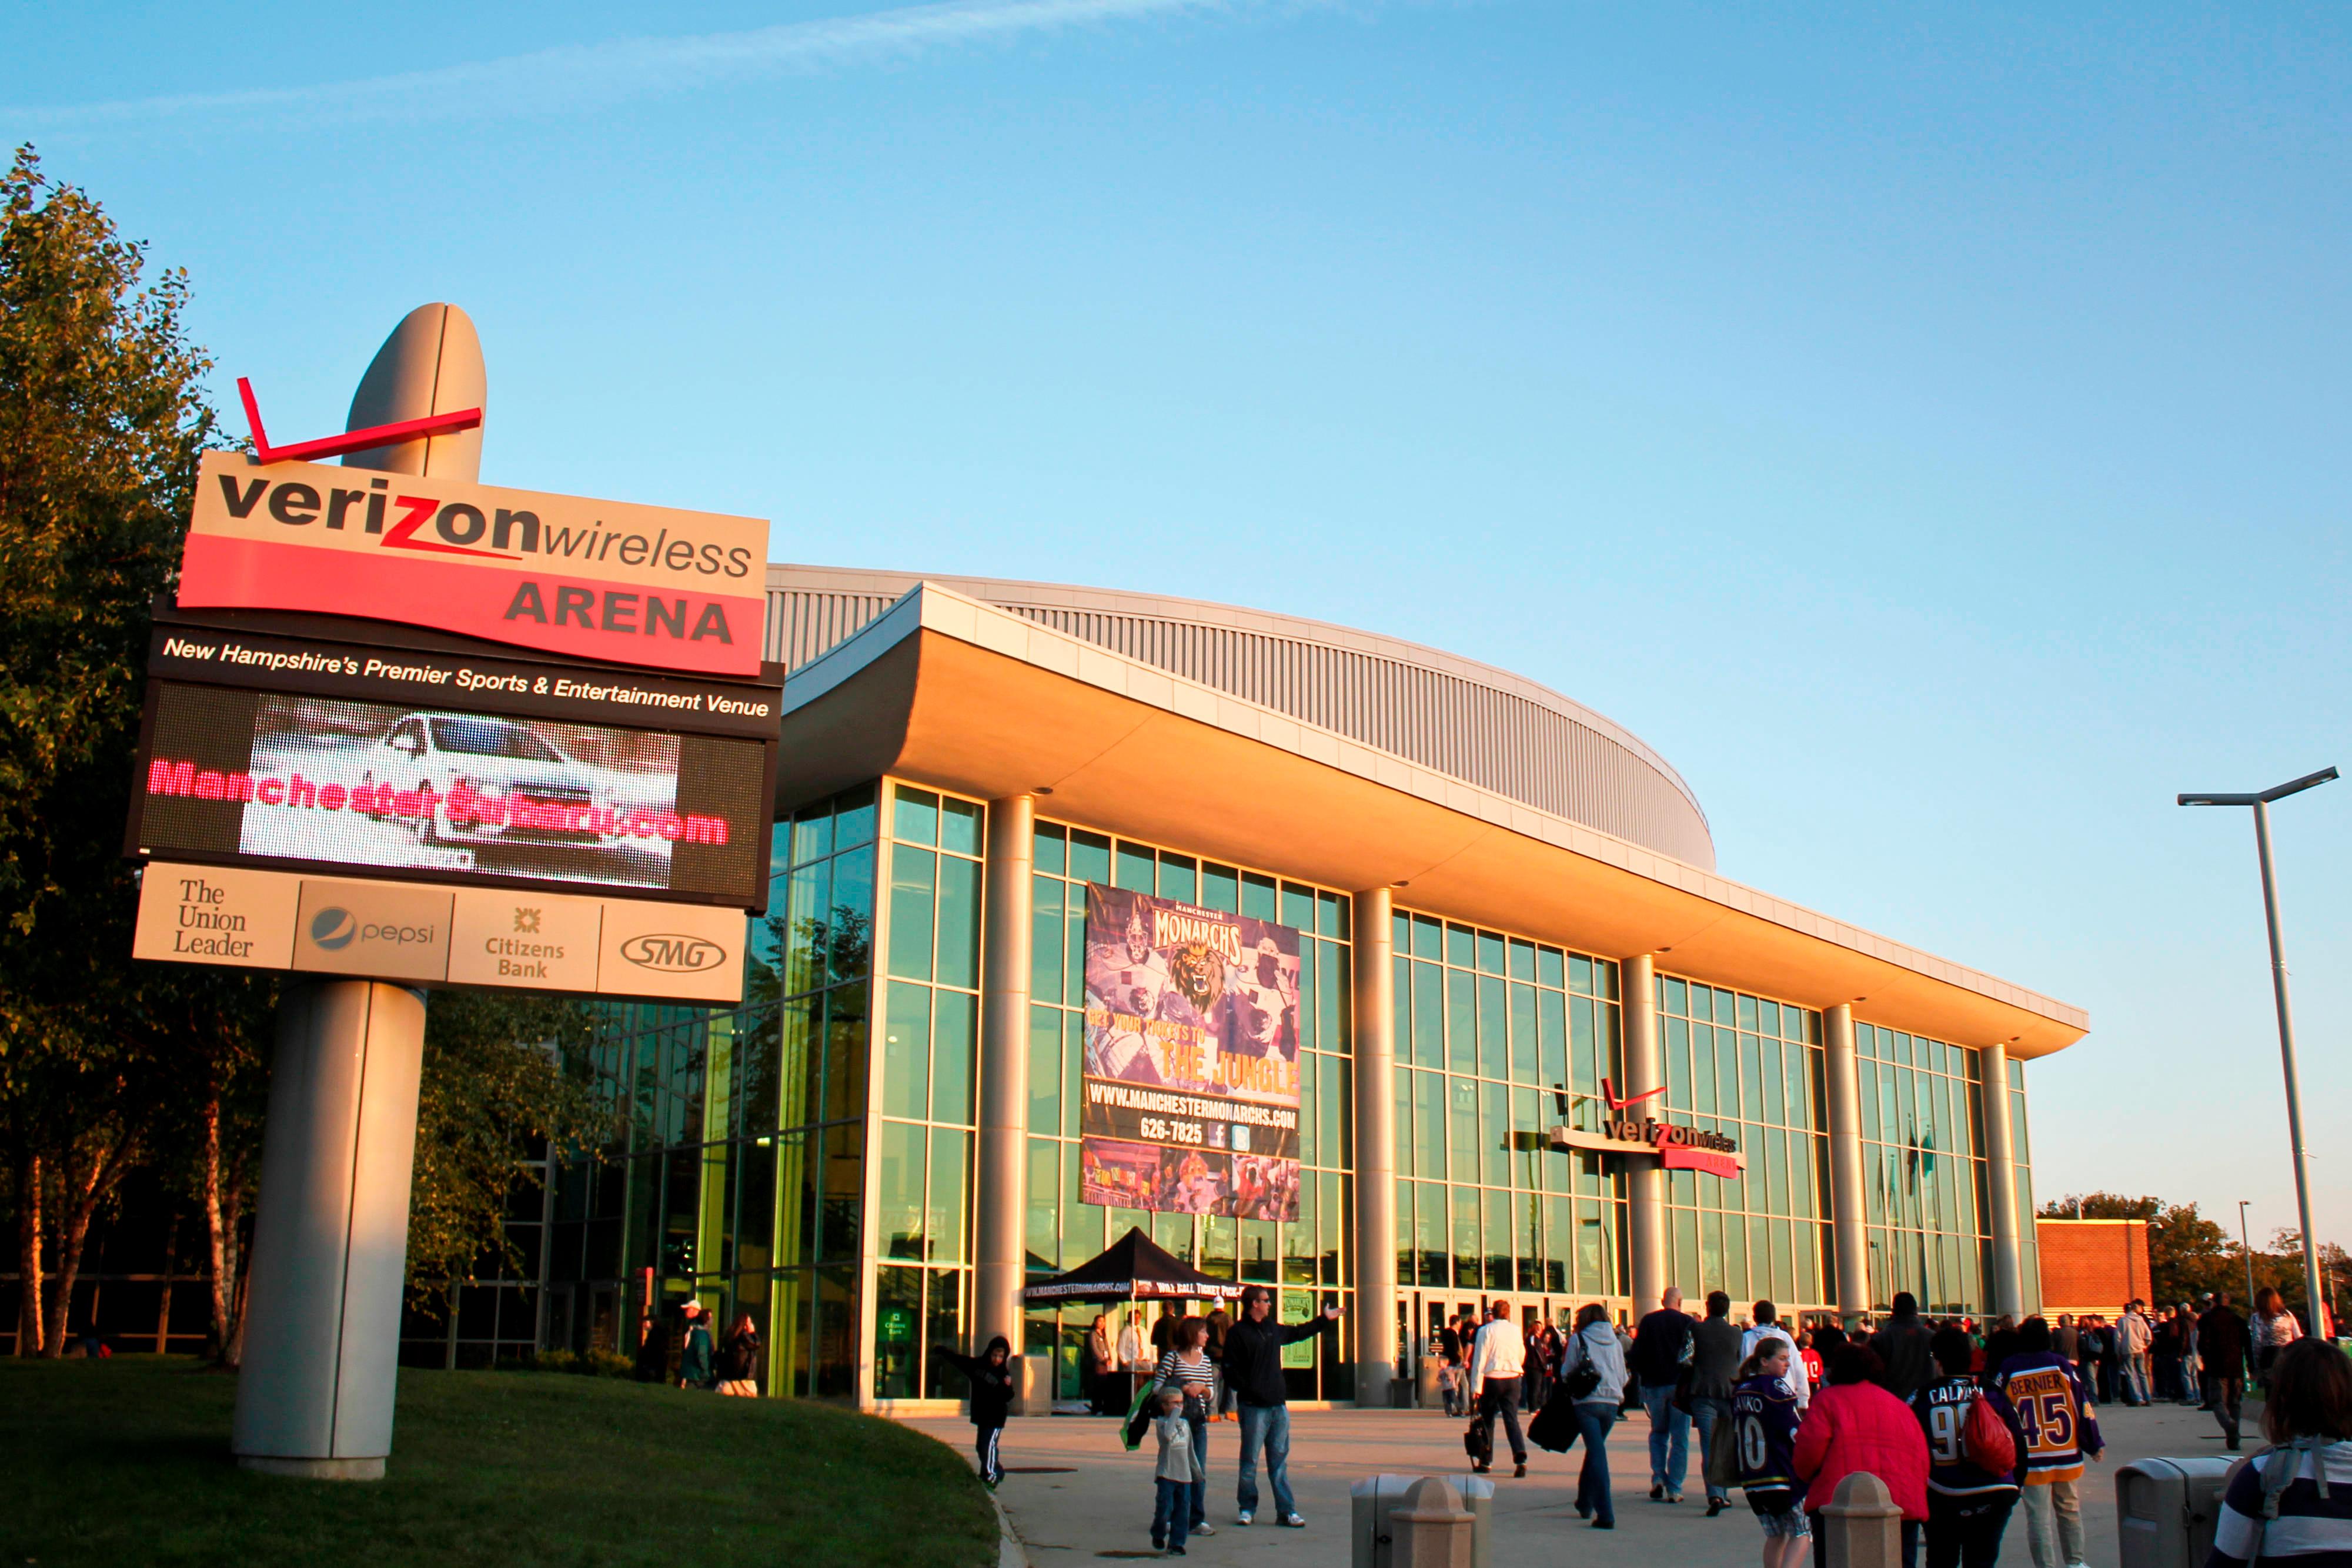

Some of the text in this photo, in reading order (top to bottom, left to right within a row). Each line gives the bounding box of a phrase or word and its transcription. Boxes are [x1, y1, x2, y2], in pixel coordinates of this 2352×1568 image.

[503, 581, 734, 646] ARENA
[163, 637, 770, 718] New Hampshire's Premier Sports & Entertainment Venue
[180, 879, 225, 905] The
[179, 905, 246, 932] Union
[1176, 903, 1223, 921] MANCHESTER
[173, 930, 253, 958] Leader
[361, 923, 434, 945] pepsi
[485, 937, 564, 959] Citizens
[1153, 908, 1242, 967] MONARCHS
[632, 938, 706, 968] SMG
[497, 959, 548, 979] Bank
[1088, 1009, 1205, 1044] GET YOUR TICKETS TO
[1159, 1041, 1299, 1096] THE JUNGLE
[1090, 1083, 1297, 1129] WWW.MANCHESTERMONARCHS.COM
[1140, 1117, 1202, 1145] 626-7825
[1157, 1282, 1176, 1294] WILL
[1177, 1283, 1195, 1294] CALL
[1196, 1283, 1220, 1298] TICKET
[2010, 1373, 2063, 1396] BERNIER
[2015, 1392, 2073, 1449] 45
[1734, 1416, 1766, 1472] 10
